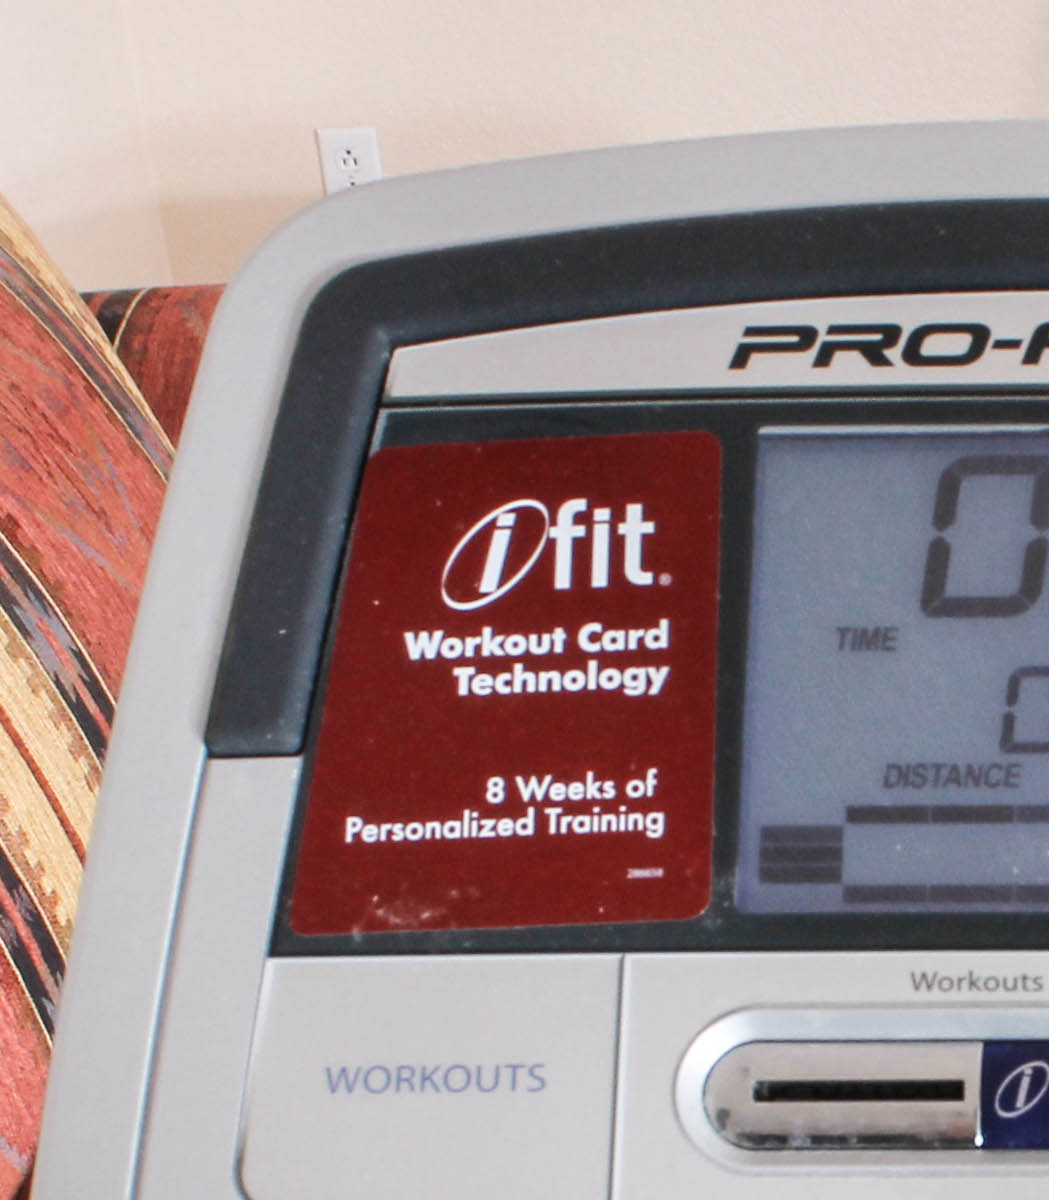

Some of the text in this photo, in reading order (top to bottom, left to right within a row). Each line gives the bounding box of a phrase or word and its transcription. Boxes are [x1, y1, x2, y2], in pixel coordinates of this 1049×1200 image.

[404, 619, 669, 660] Workout Card
[836, 626, 898, 651] TIME
[453, 661, 669, 696] Technology
[485, 769, 657, 803] 8 Weeks of
[882, 763, 1023, 789] DISTANCE
[345, 807, 665, 843] Personalized Training
[910, 970, 1044, 993] Workouts
[325, 1063, 547, 1094] WORKOUTS
